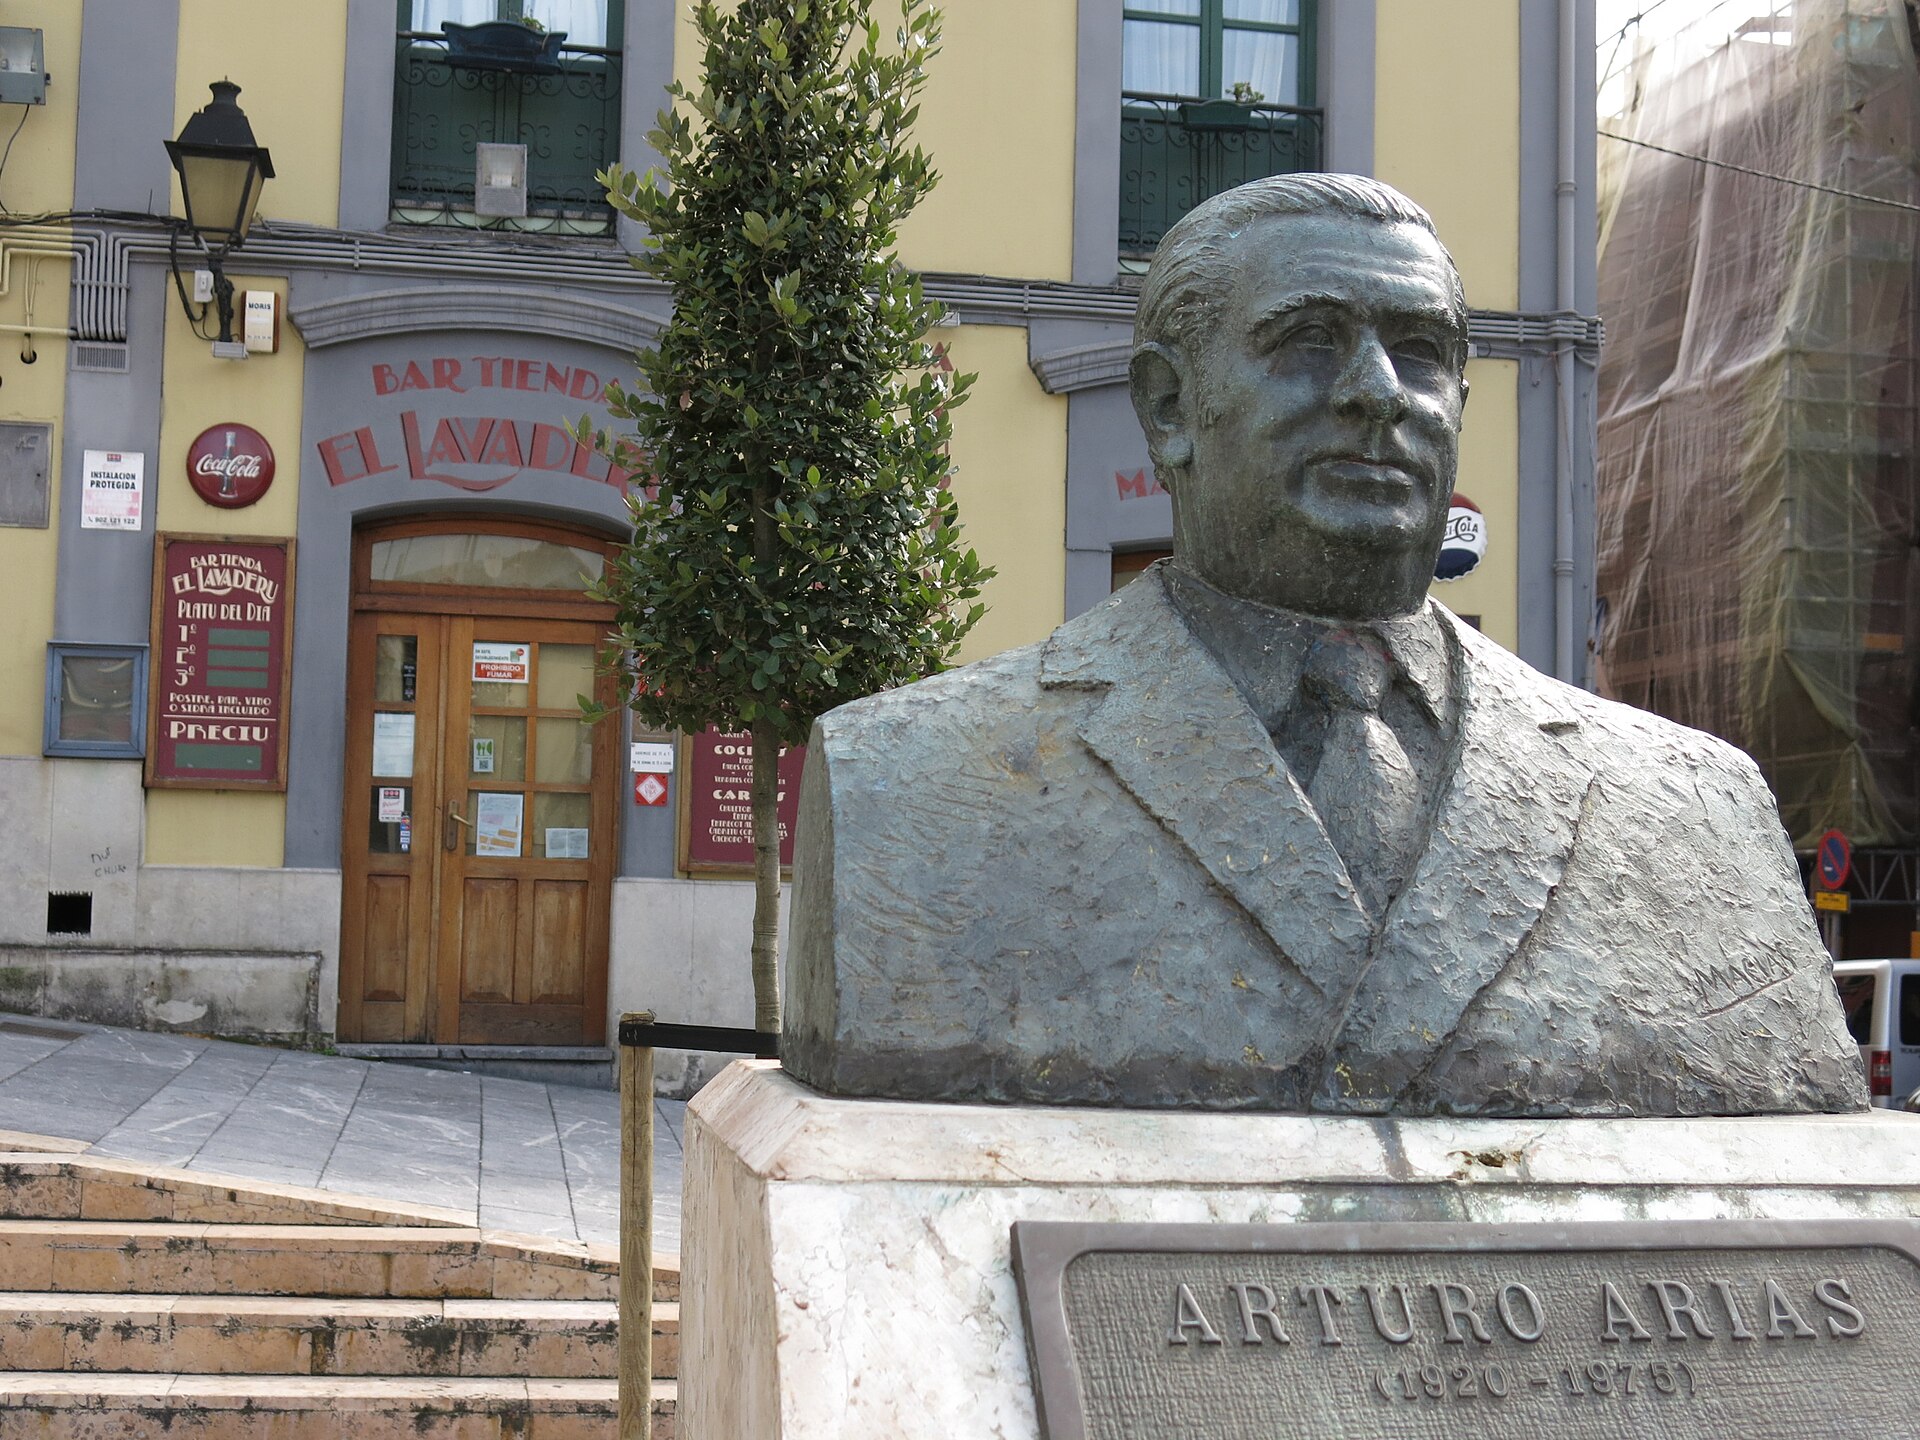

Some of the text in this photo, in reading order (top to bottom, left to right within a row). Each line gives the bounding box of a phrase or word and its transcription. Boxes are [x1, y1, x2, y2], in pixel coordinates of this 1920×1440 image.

[372, 357, 467, 396] BAR
[317, 425, 400, 488] EL
[90, 471, 136, 480] INSTALACION
[90, 480, 136, 490] PROTEGIDA
[190, 553, 262, 573] BAR TIENDA
[172, 566, 279, 605] EL LAVADERU
[178, 599, 271, 622] PLATU DEL DIA
[480, 663, 521, 672] PROHIBIDO
[486, 671, 513, 679] FUMAR
[169, 703, 270, 716] O SIDRA INCLUIDO
[244, 697, 272, 706] VINO
[169, 720, 269, 742] PRECIU
[1168, 1279, 1866, 1345] ARTURO ARIAS
[1374, 1363, 1511, 1400] (1920
[1563, 1360, 1697, 1396] 1975)
